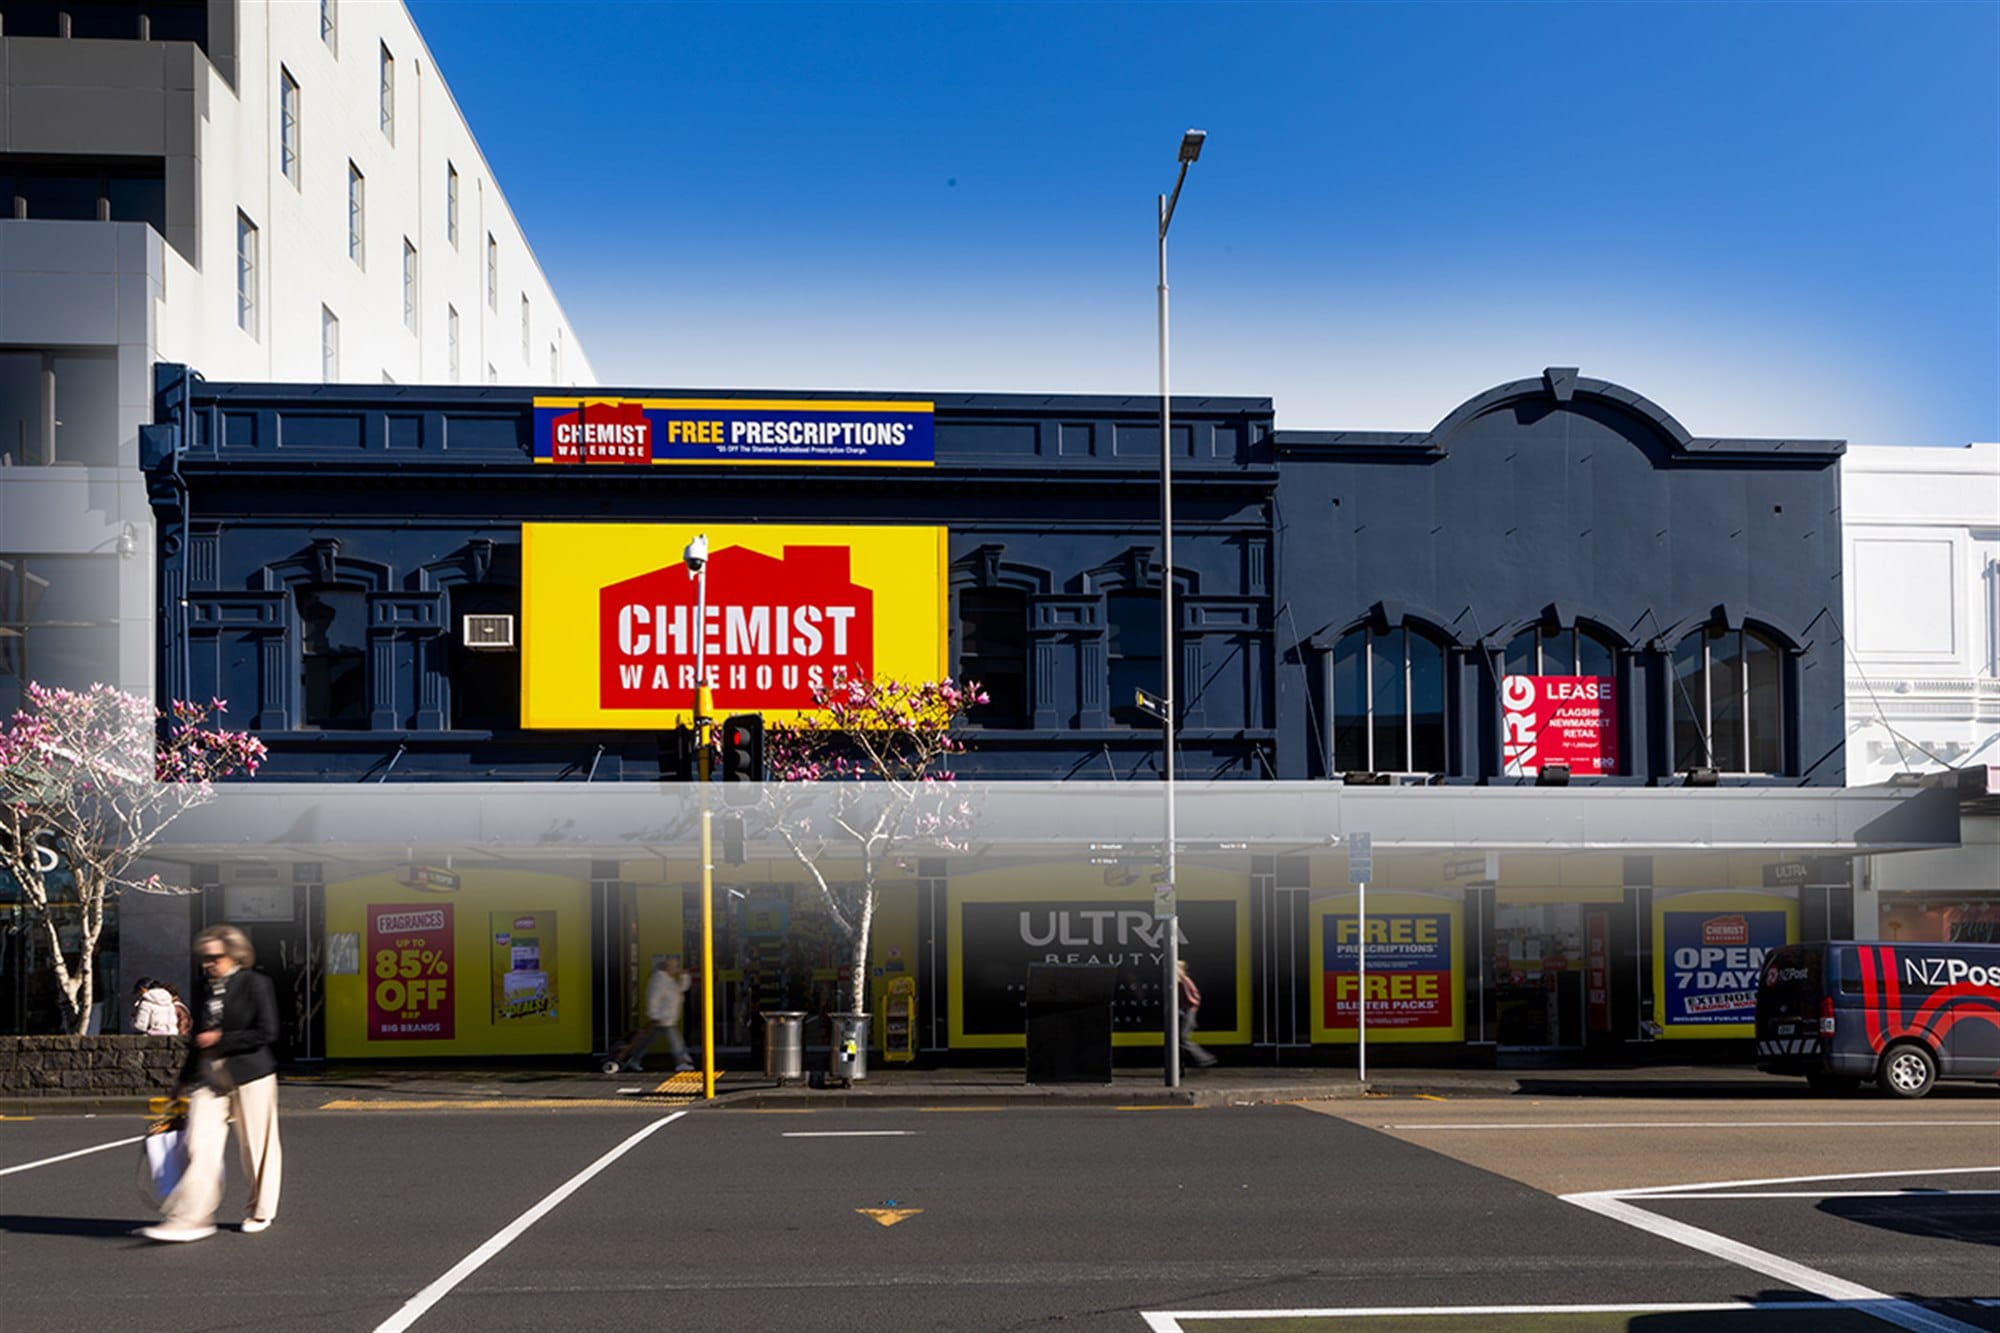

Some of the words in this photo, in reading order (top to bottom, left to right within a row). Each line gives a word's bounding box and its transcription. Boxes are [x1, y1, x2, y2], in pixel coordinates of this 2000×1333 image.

[557, 423, 647, 444] CHEMIST
[667, 421, 724, 443] FREE
[558, 446, 645, 457] WAREHOUSE
[618, 604, 856, 656] CHEMIST
[1547, 683, 1611, 699] LEASE
[1556, 708, 1604, 717] FLAGSHIP
[1549, 719, 1610, 728] NEWMARKET
[1563, 729, 1597, 738] RETAIL
[379, 912, 443, 931] FRAGRANCES
[1019, 910, 1190, 948] ULTRA
[1336, 918, 1438, 944] FREE
[395, 938, 410, 948] UP
[412, 938, 426, 948] TO
[375, 949, 448, 978] 85%
[1904, 958, 2000, 987] NZPos
[1336, 975, 1439, 1000] FREE
[1674, 972, 1694, 989] 7
[375, 979, 447, 1012] OFF
[1336, 1001, 1389, 1010] BLITER
[381, 1024, 398, 1033] BIG
[401, 1023, 440, 1032] BRANDS
